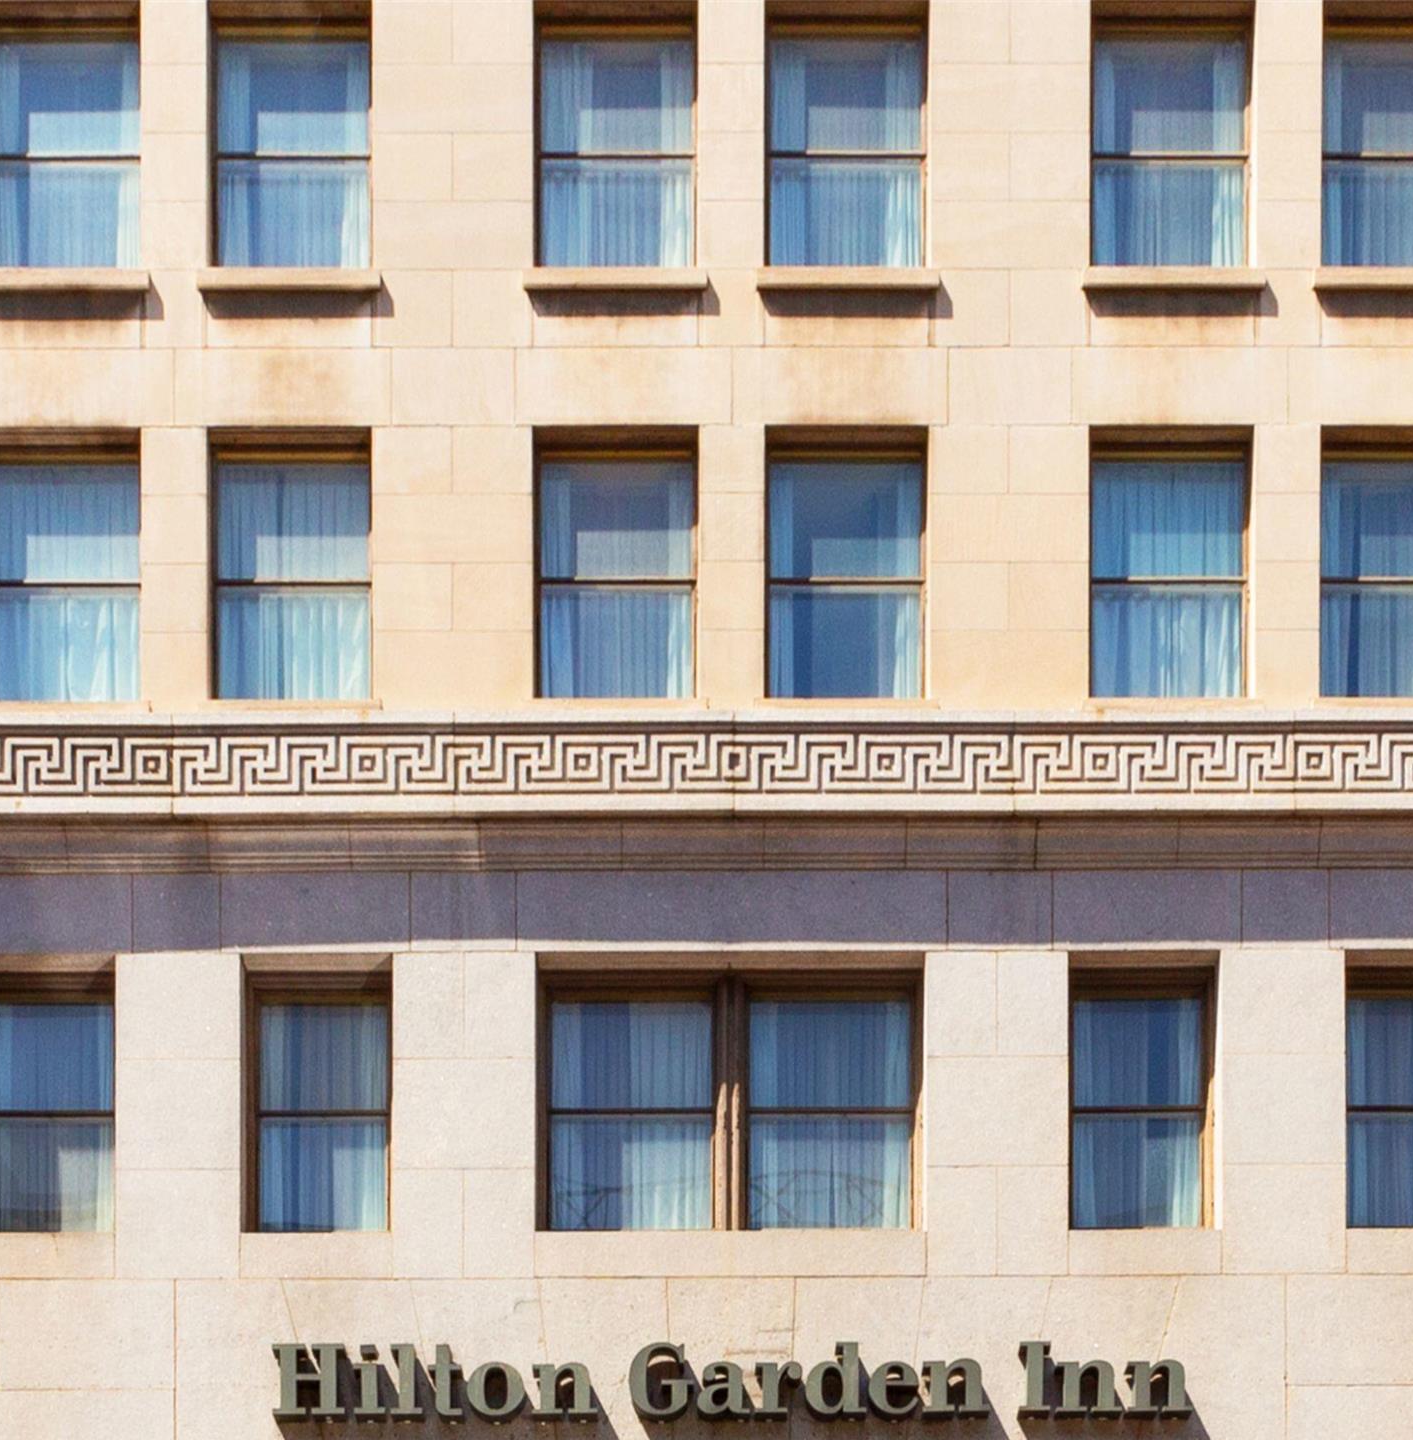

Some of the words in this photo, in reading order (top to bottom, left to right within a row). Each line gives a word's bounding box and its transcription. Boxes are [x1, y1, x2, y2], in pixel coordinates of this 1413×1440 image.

[272, 1343, 600, 1420] Hilton
[629, 1341, 990, 1420] Garden
[1018, 1341, 1193, 1419] Inn
